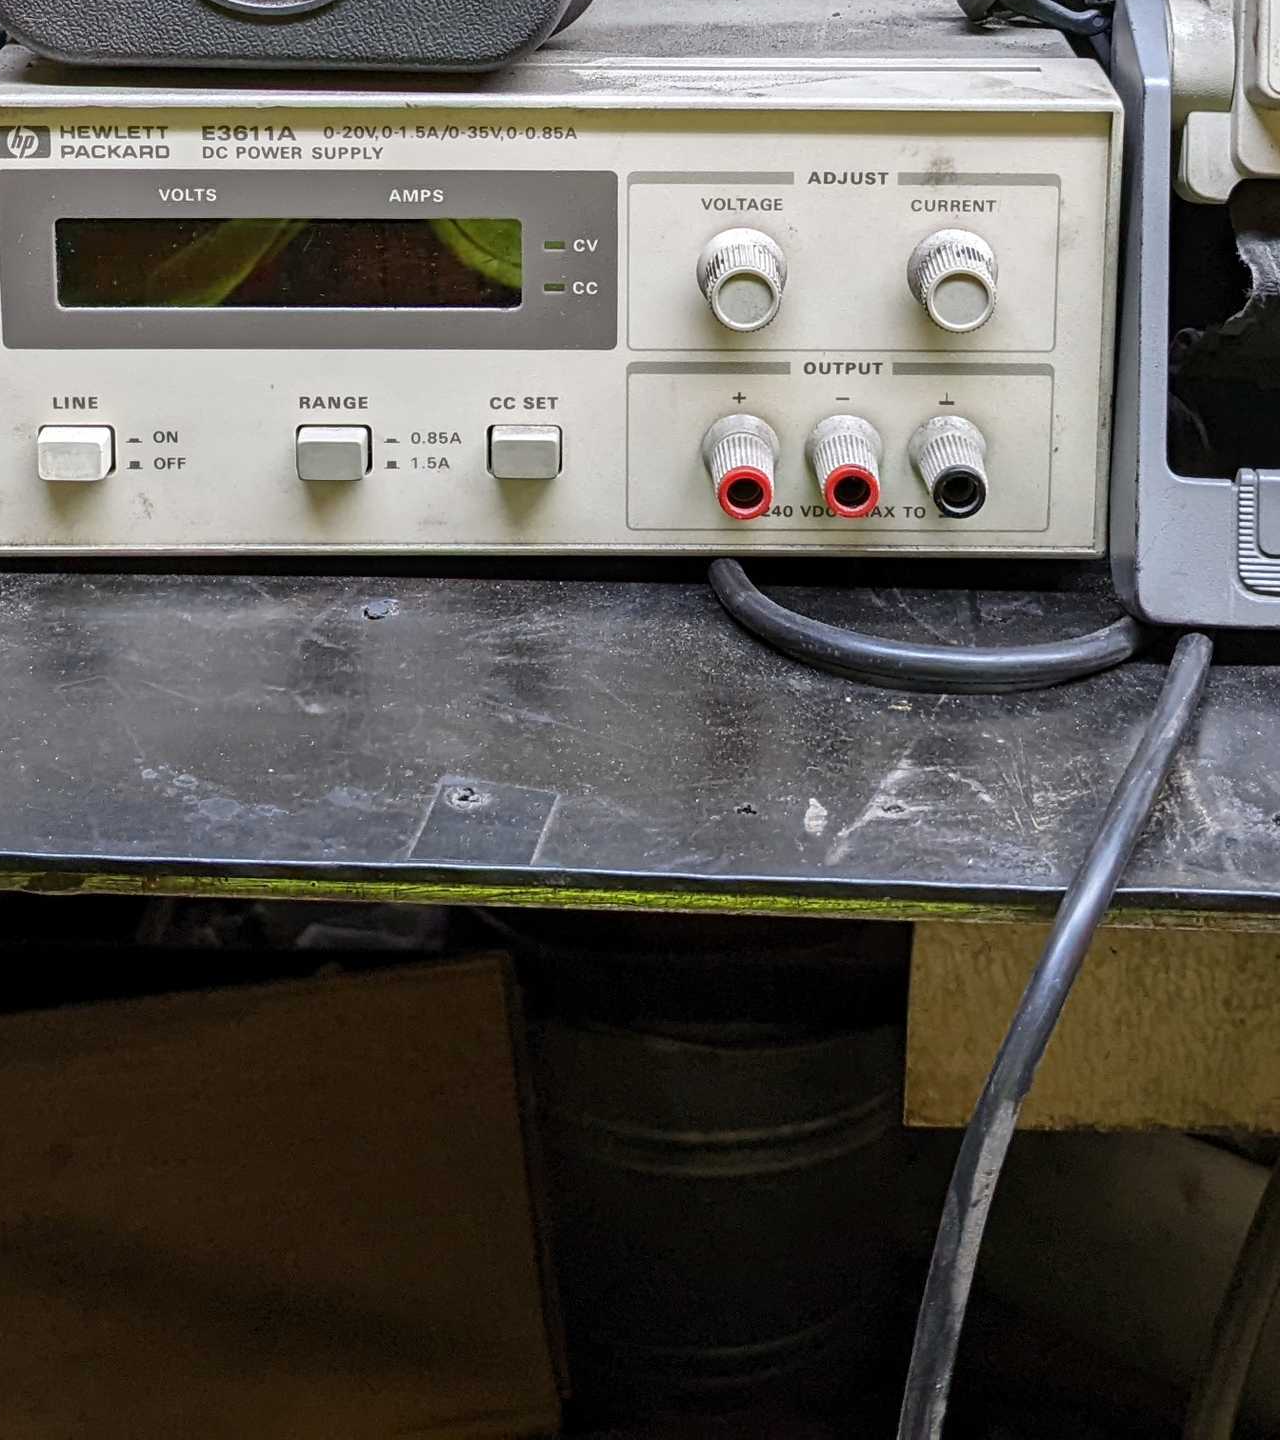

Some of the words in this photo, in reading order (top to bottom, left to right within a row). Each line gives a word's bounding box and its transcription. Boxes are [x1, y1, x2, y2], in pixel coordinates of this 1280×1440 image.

[60, 125, 169, 141] HEWLETT
[201, 125, 296, 142] E3611A
[60, 144, 171, 160] PACKARD
[201, 145, 229, 160] DC
[235, 146, 303, 161] POWER
[311, 146, 384, 161] SUPPLY
[807, 172, 889, 186] ADJUST
[158, 187, 217, 202] VOLTS
[388, 188, 444, 204] AMPS
[701, 198, 784, 212] VOLTAGE
[911, 199, 997, 213] CURRENT
[572, 238, 599, 253] CV
[572, 280, 599, 295] CC
[803, 362, 883, 376] OUTPUT
[52, 396, 98, 410] LINE
[299, 396, 369, 411] RANGE
[489, 396, 519, 411] CC
[523, 396, 559, 411] SET
[152, 430, 179, 445] ON
[410, 431, 462, 446] 0.85A
[153, 456, 186, 471] OFF
[410, 457, 450, 471] 1.5A
[902, 505, 926, 519] TO
